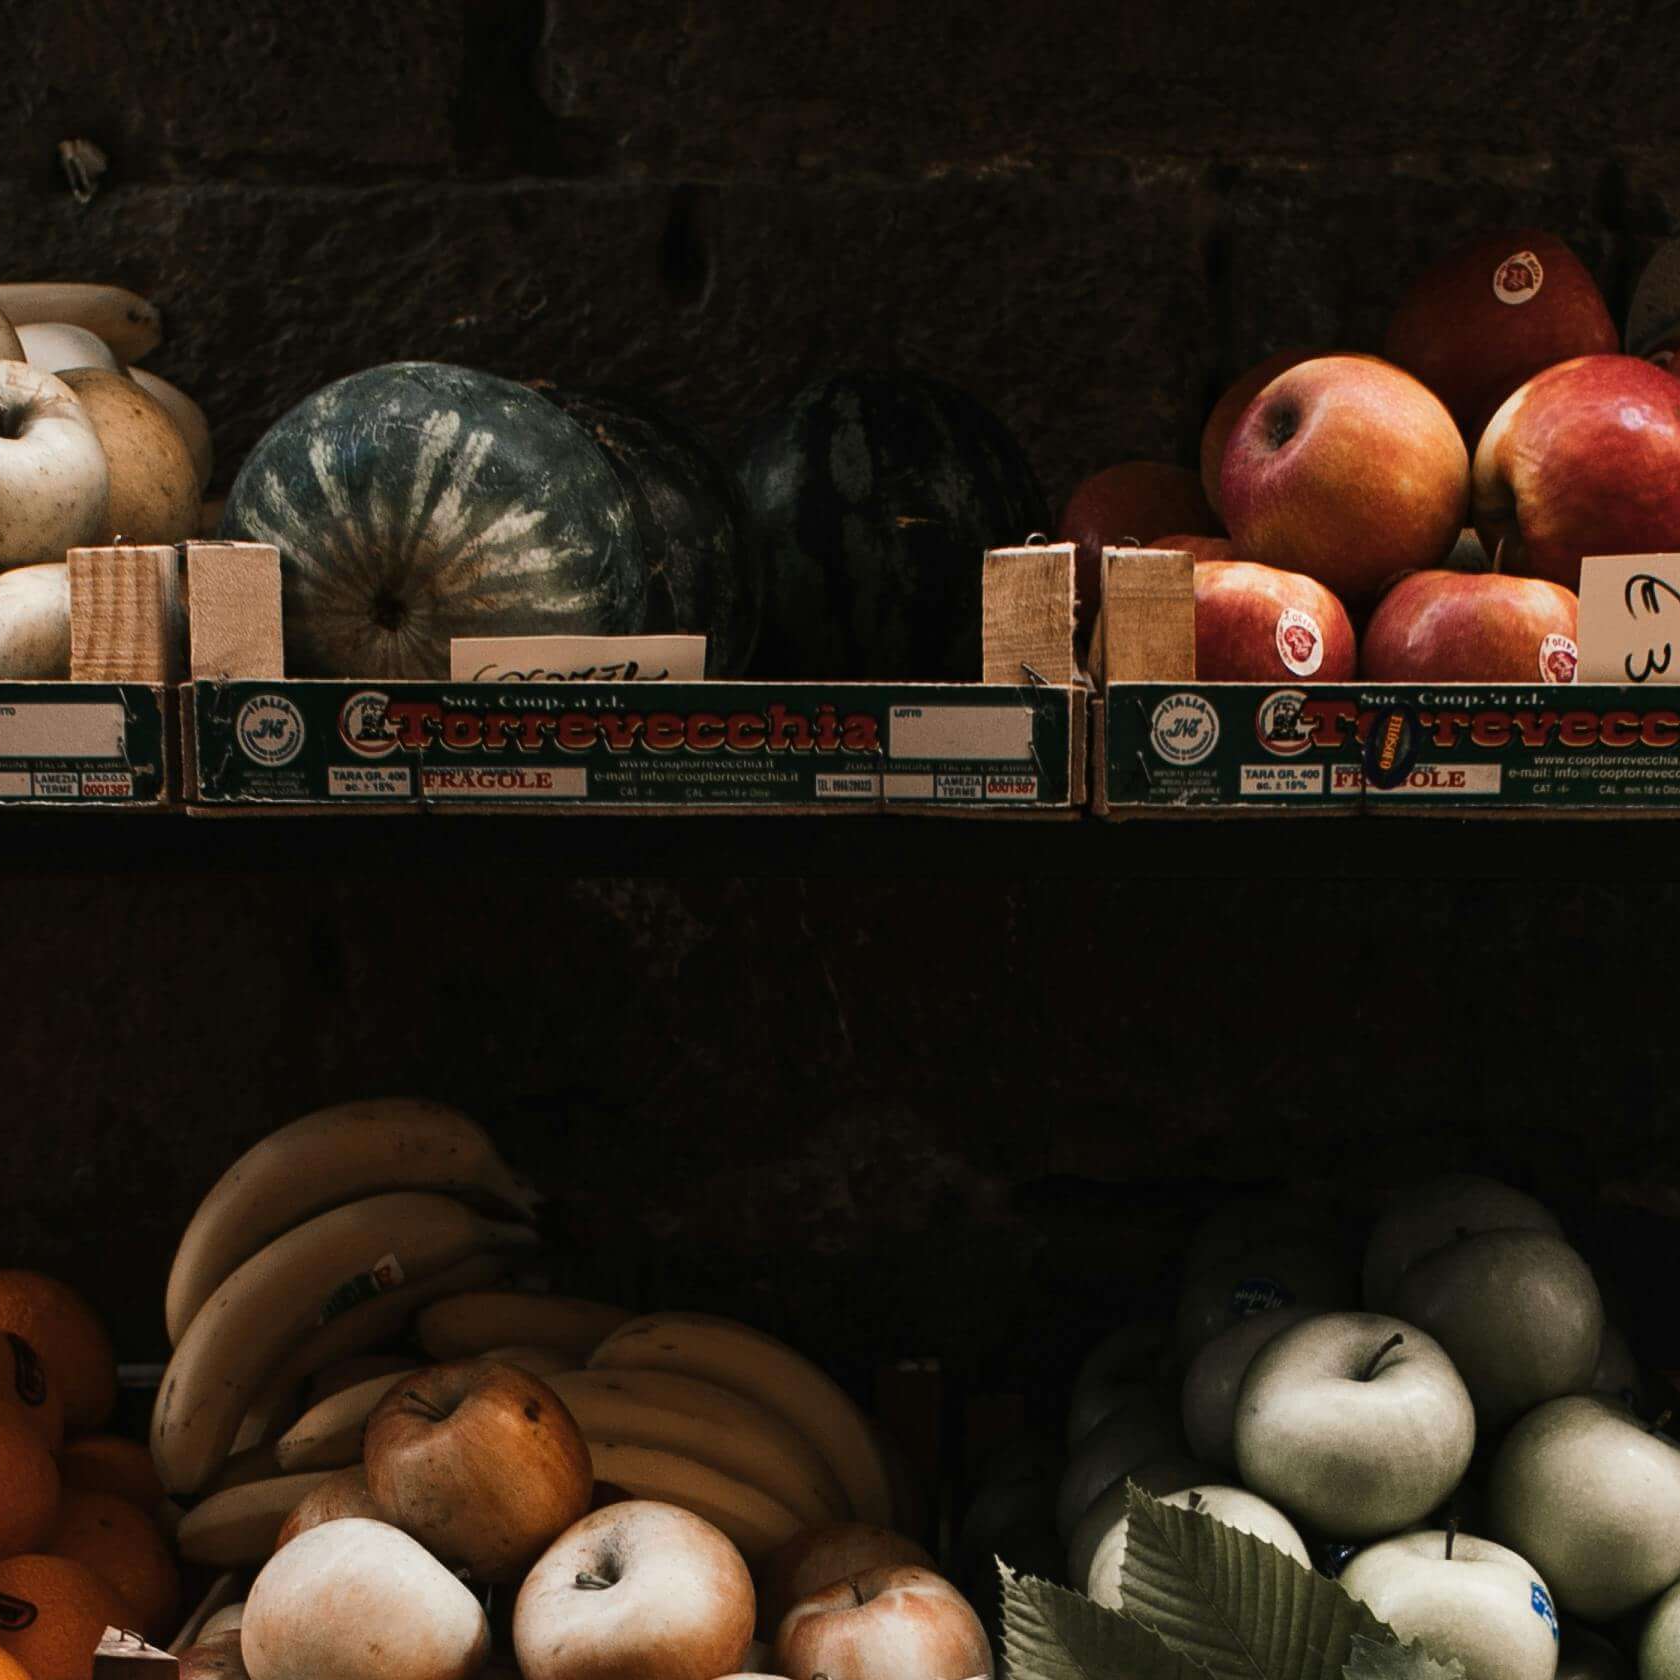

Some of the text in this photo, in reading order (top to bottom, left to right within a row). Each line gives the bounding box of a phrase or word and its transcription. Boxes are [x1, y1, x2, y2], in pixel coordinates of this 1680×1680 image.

[1624, 643, 1672, 683] 3
[386, 703, 883, 755] Torrevecchia
[1380, 713, 1404, 769] FILOSOFO
[422, 772, 554, 790] FRAGOLE
[1246, 769, 1275, 779] TARA
[1334, 771, 1467, 789] FROLE
